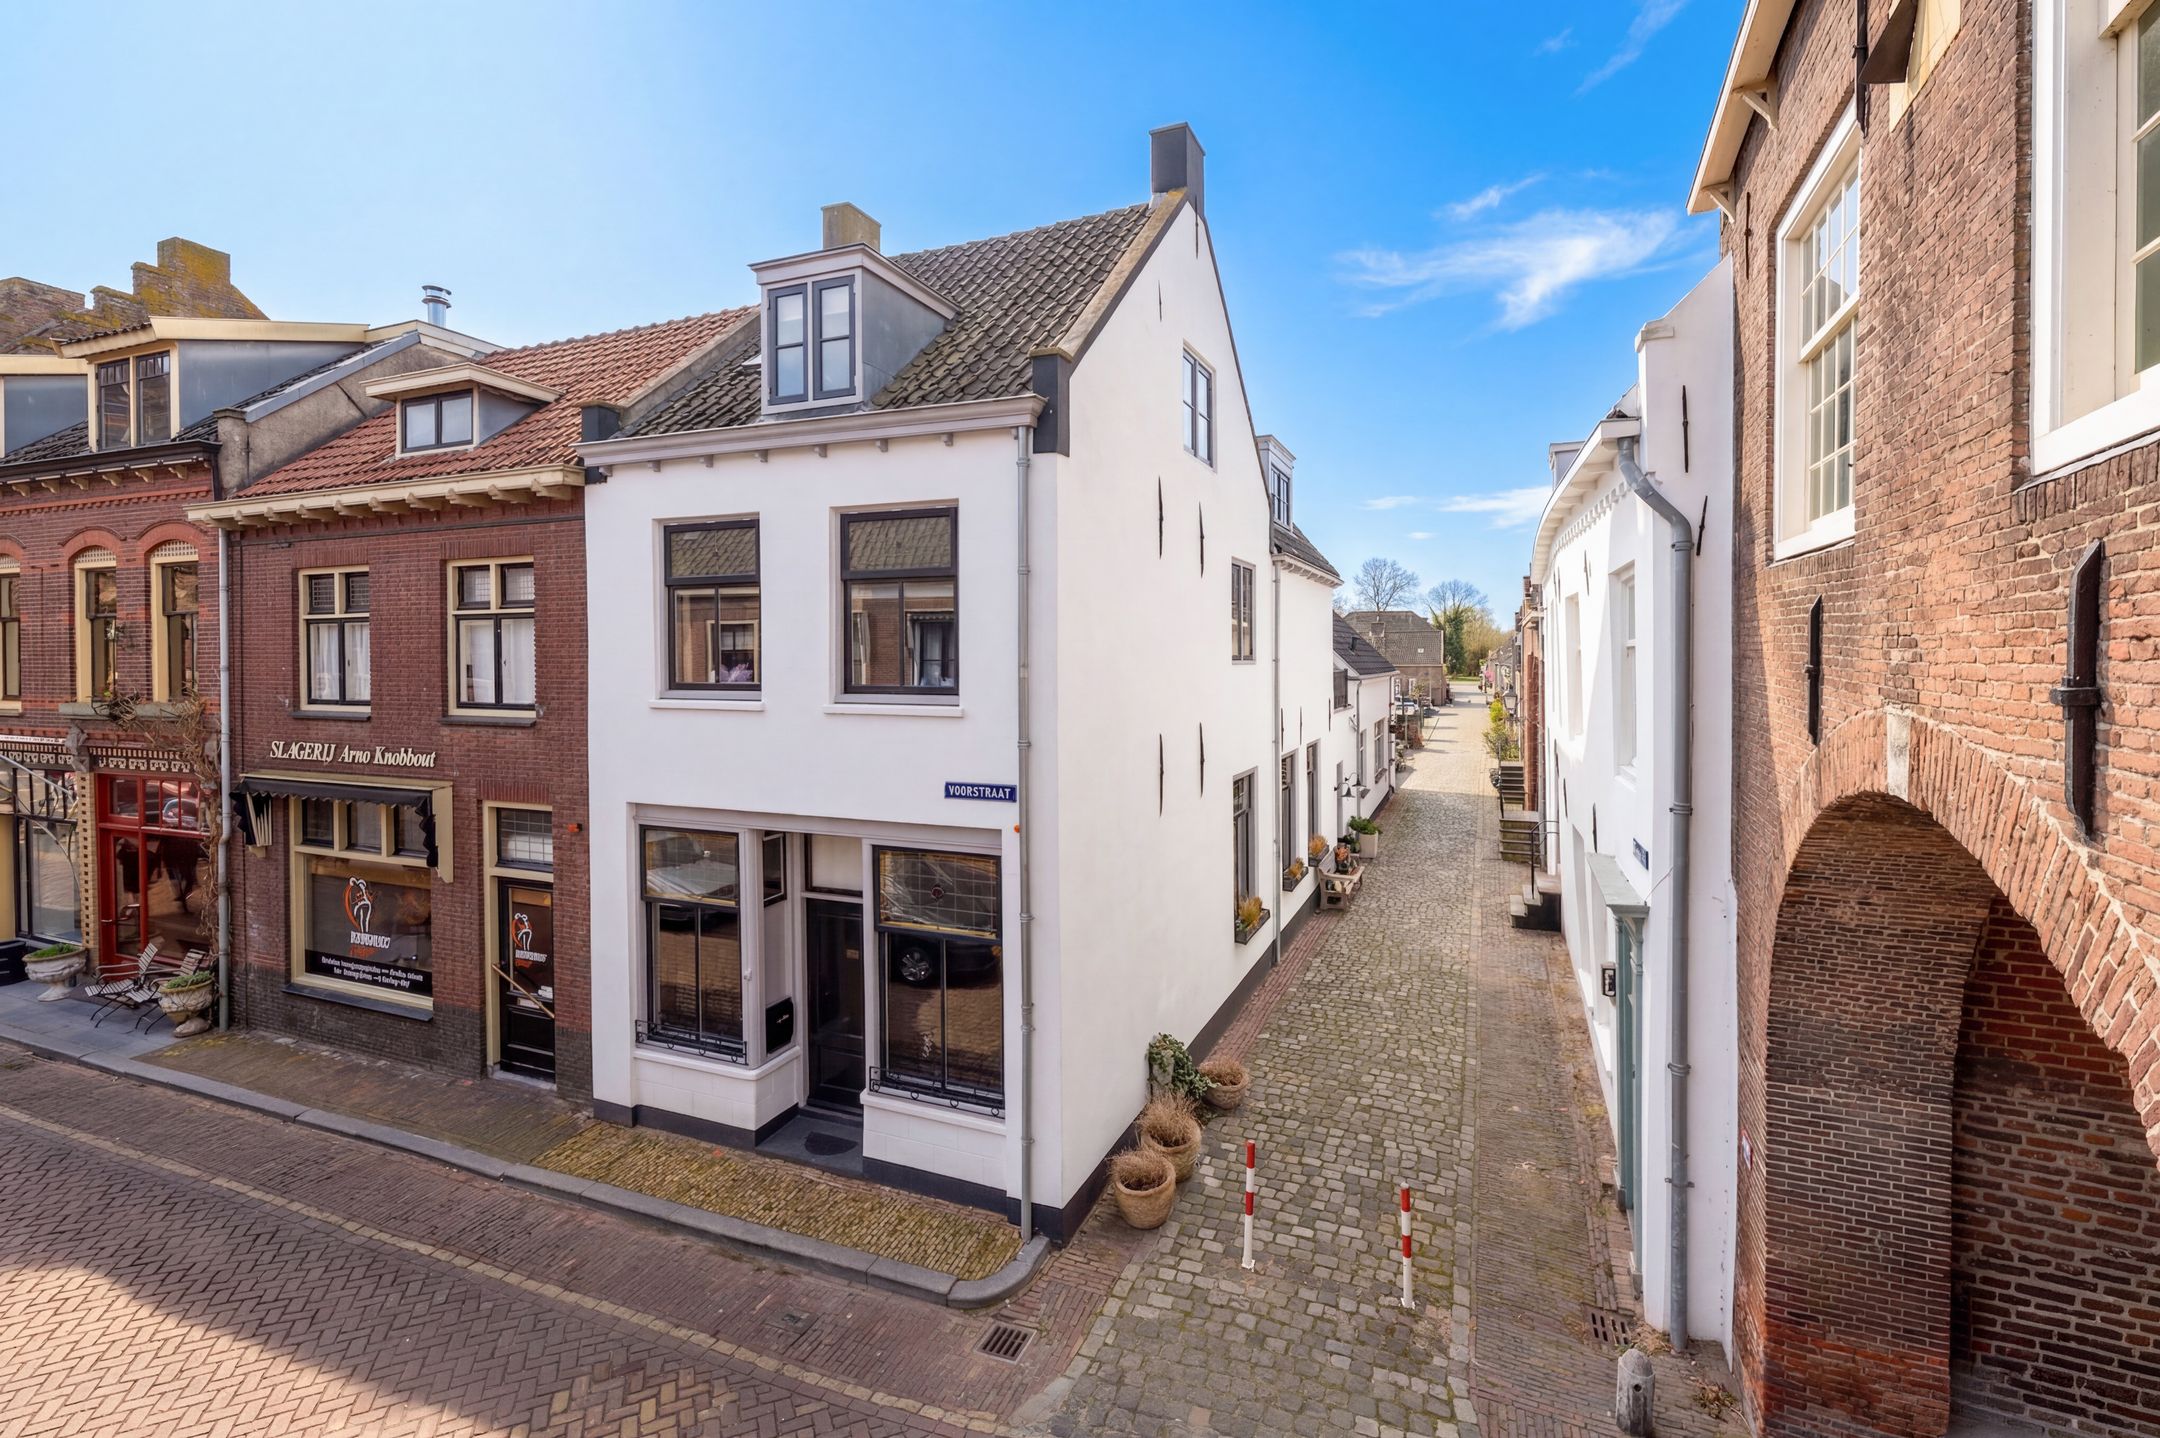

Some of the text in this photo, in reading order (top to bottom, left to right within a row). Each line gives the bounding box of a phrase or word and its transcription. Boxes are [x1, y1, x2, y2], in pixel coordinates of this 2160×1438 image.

[270, 740, 436, 768] SLAGERIJ Arno Knobbout
[948, 785, 1011, 799] VOORSTRAAT
